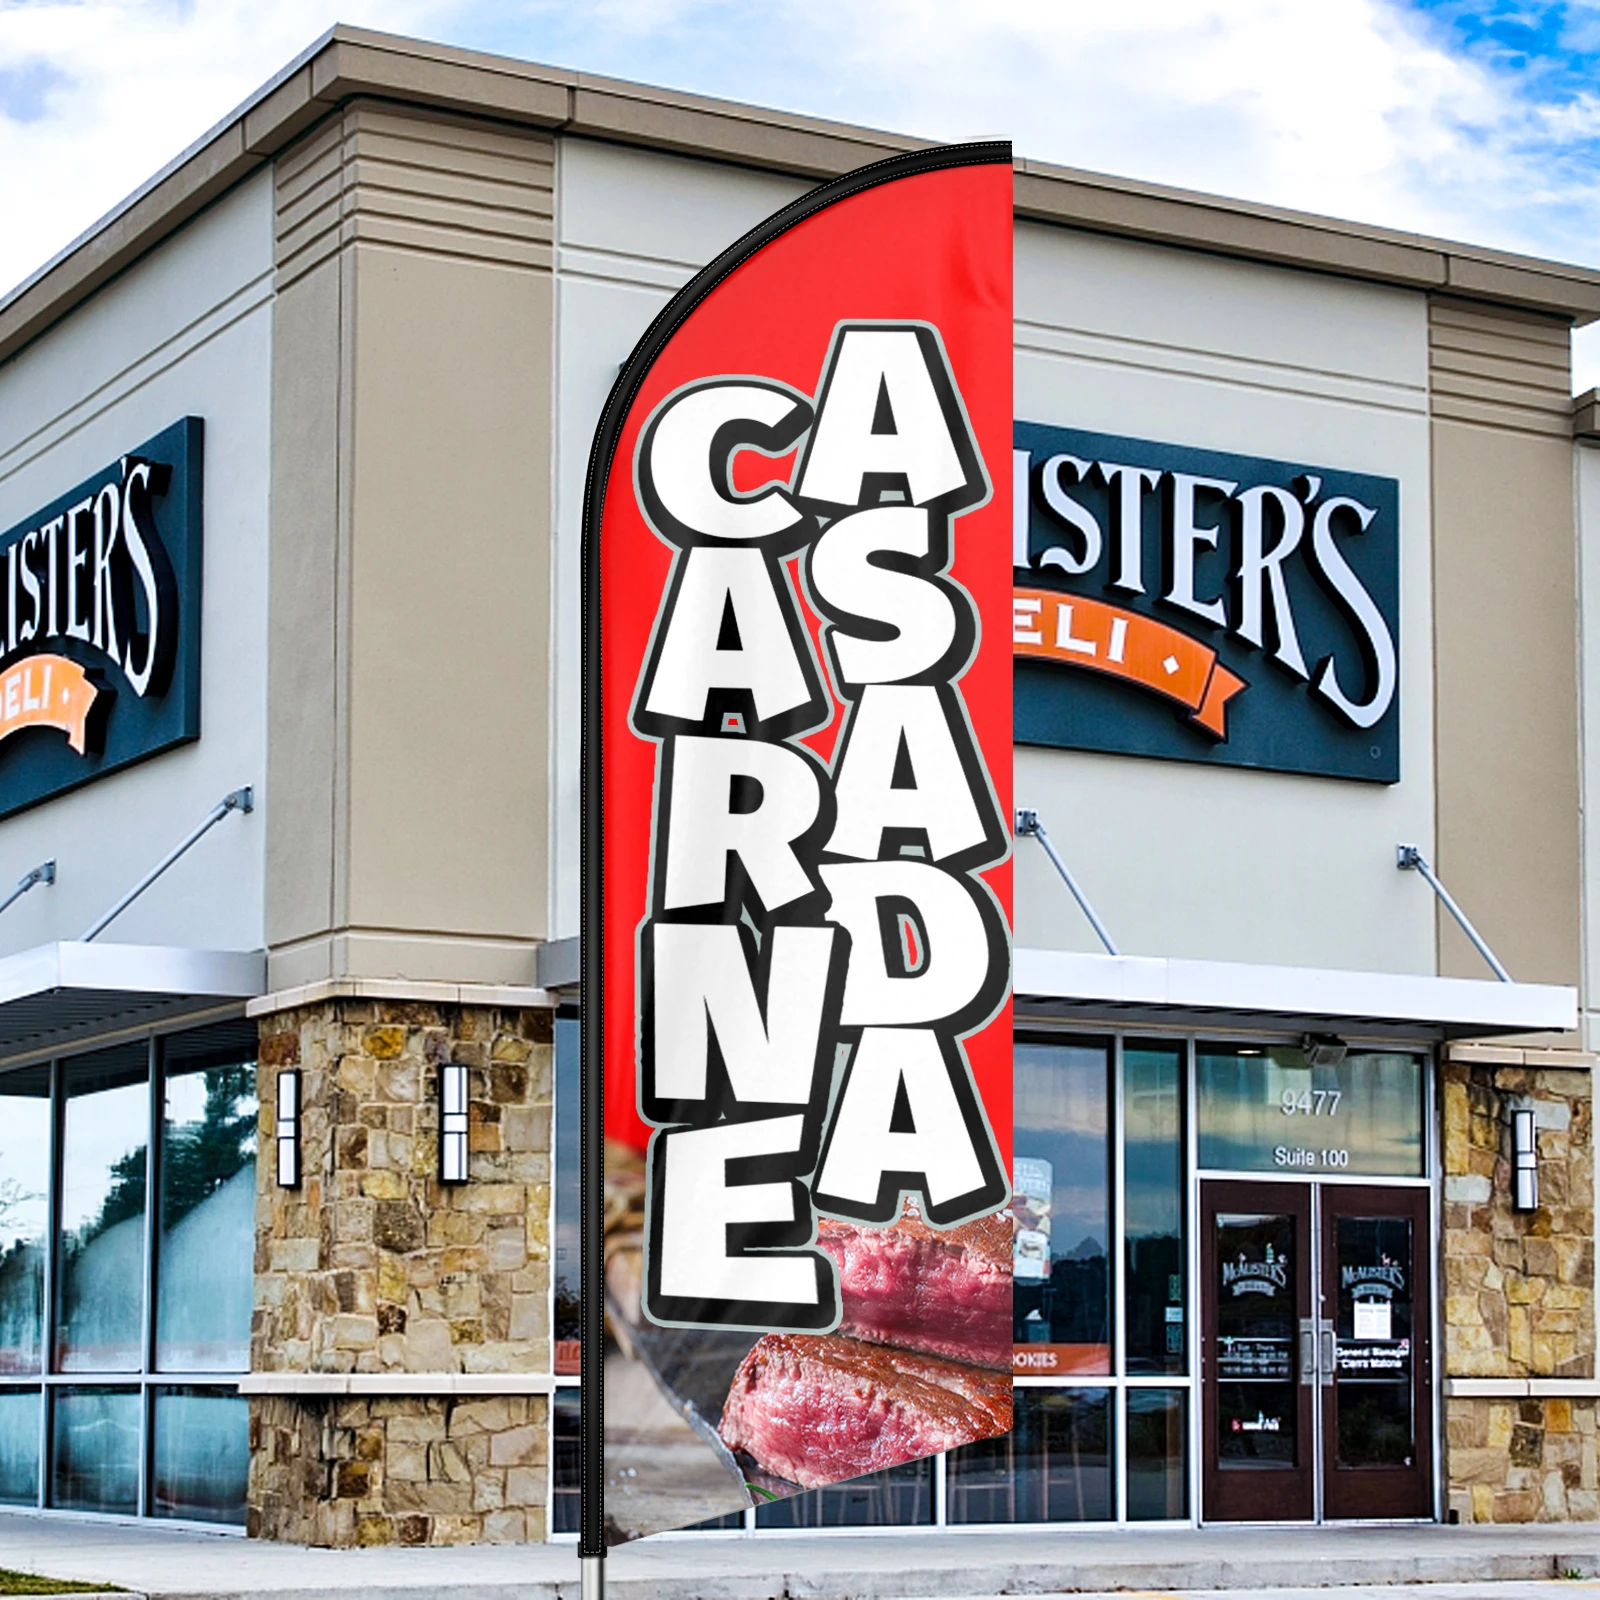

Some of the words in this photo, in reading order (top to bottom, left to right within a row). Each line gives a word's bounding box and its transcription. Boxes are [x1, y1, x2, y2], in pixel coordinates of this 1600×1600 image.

[0, 457, 158, 697] ISTER'S
[0, 664, 53, 720] ELI
[797, 328, 990, 1208] ASADA
[640, 382, 838, 1308] CARNE
[1281, 1088, 1341, 1116] 9477
[1274, 1146, 1315, 1166] Suite
[1321, 1149, 1348, 1167] 100
[1013, 1352, 1058, 1368] OKIES
